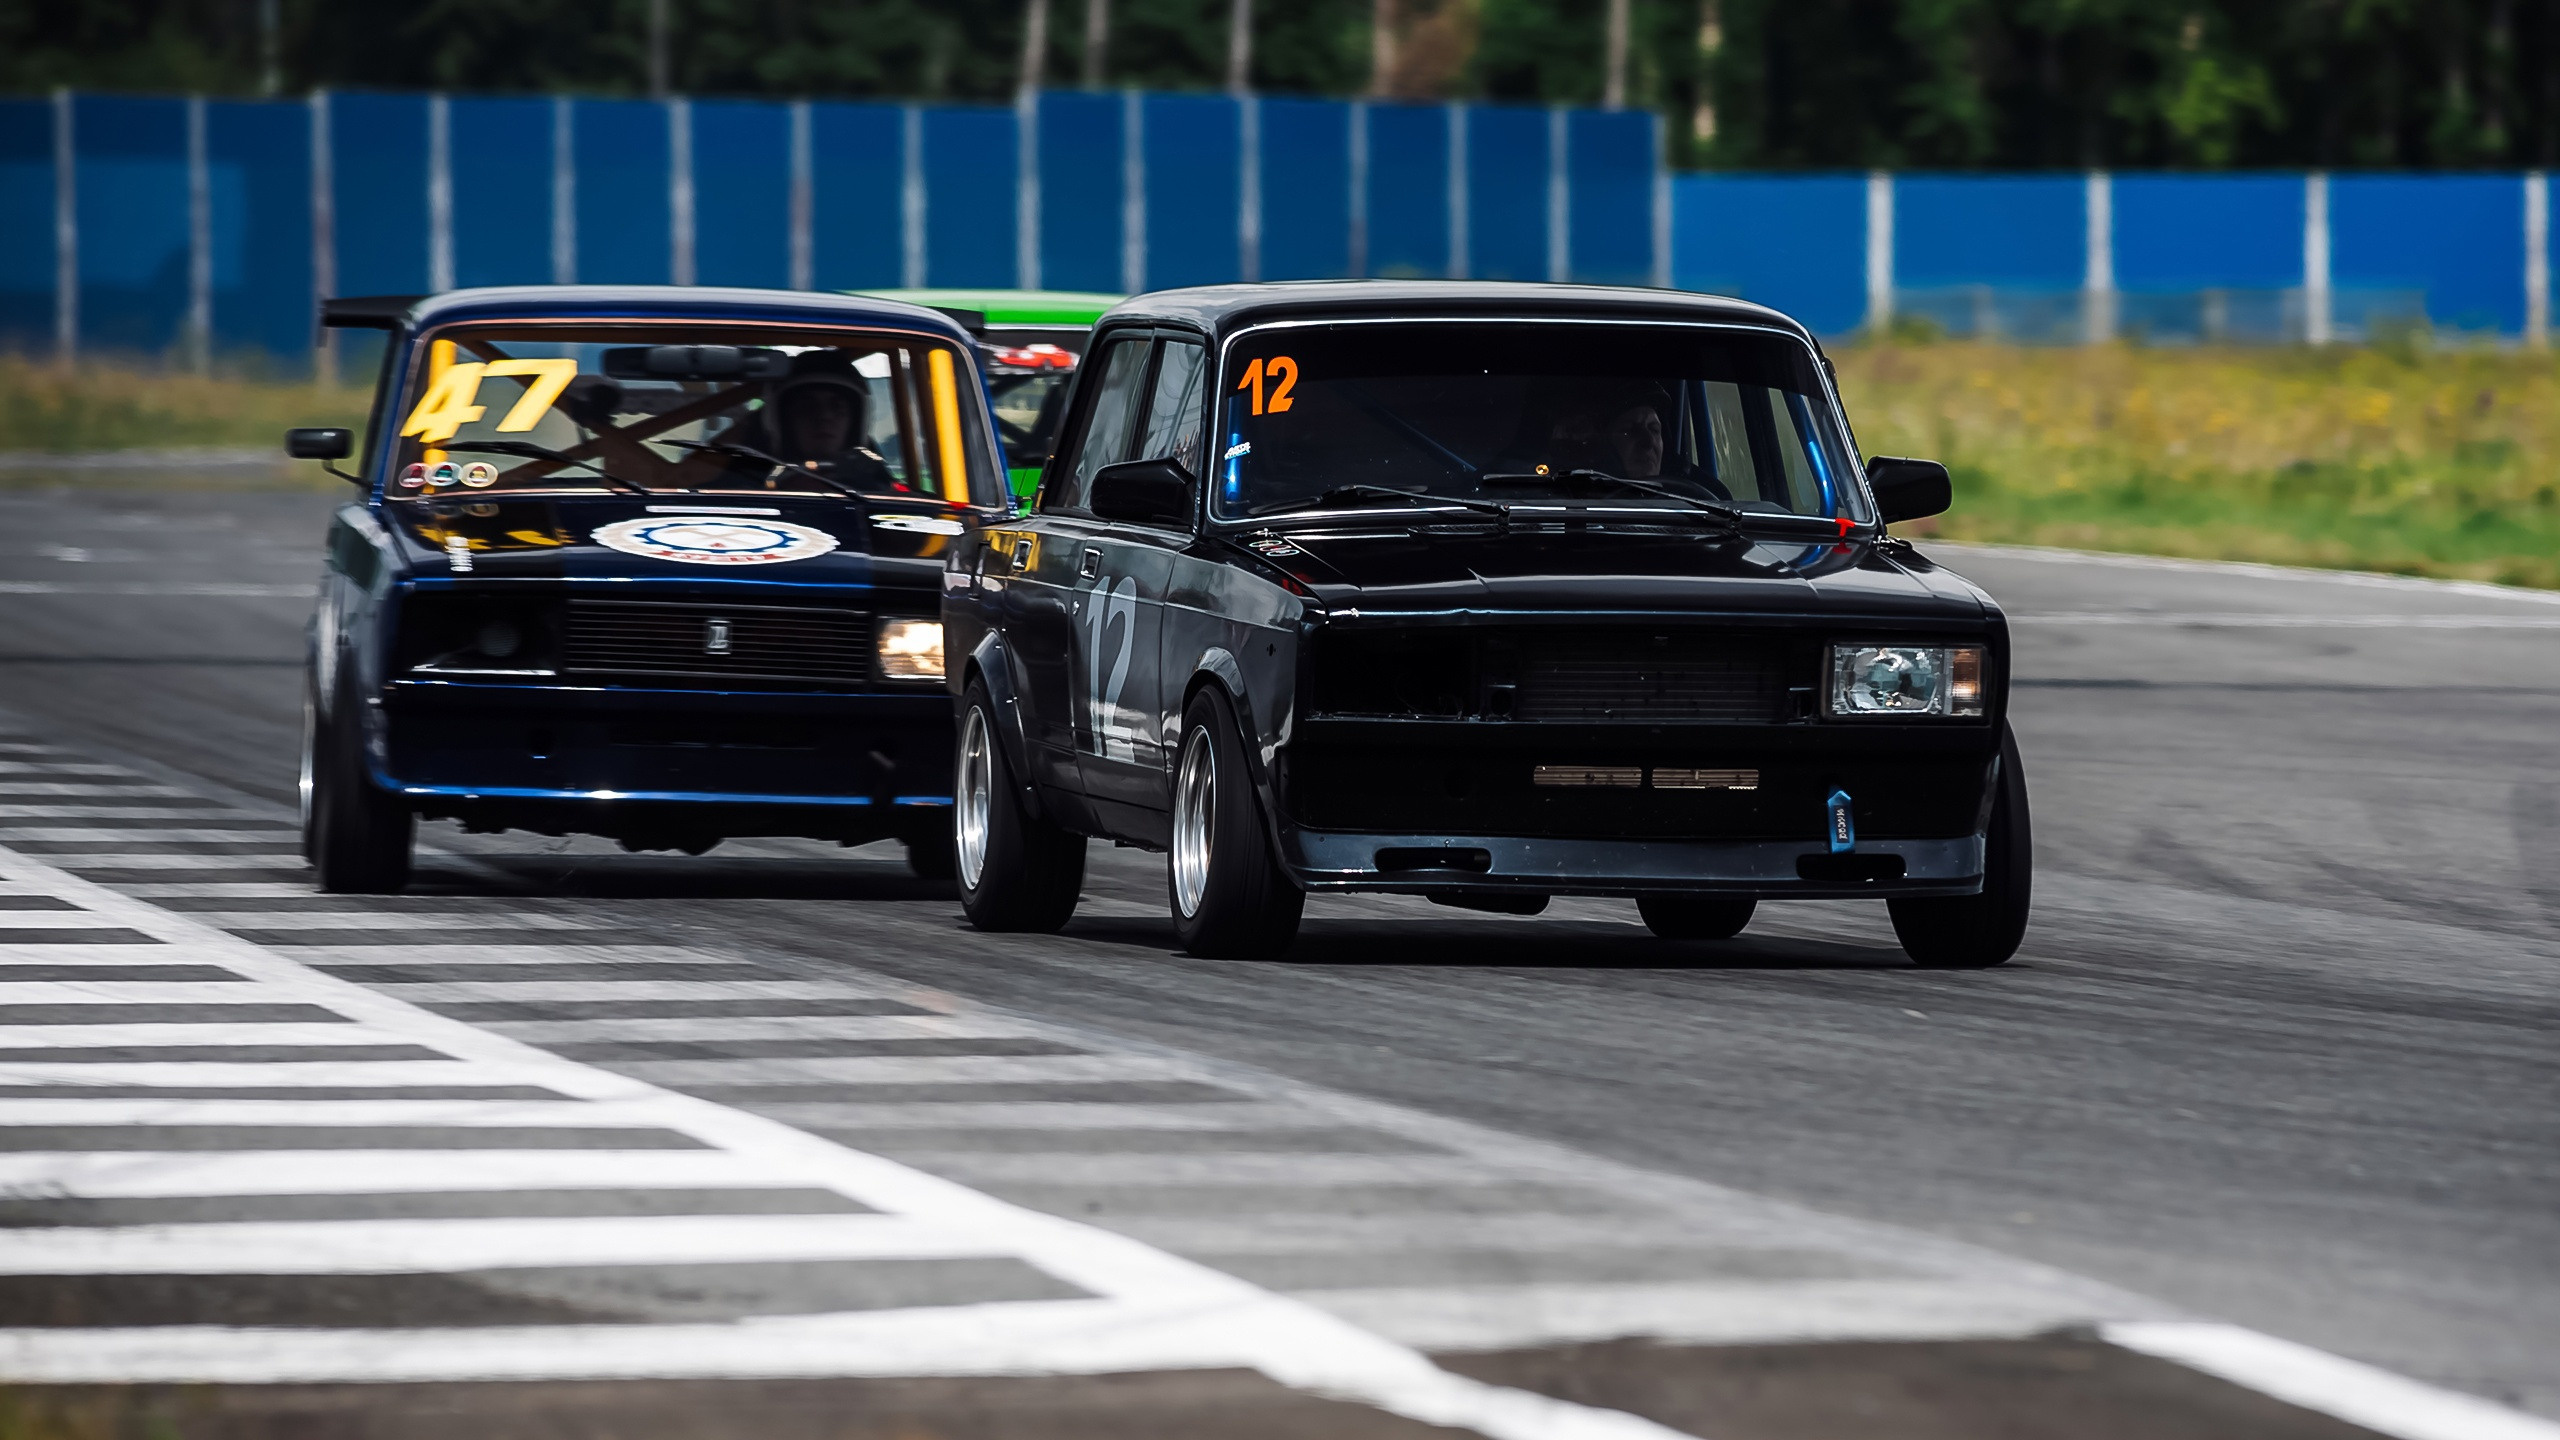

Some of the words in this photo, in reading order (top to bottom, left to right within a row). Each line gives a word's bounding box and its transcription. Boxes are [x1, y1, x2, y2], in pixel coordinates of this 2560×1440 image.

[399, 358, 578, 443] 47
[1237, 356, 1299, 416] 12
[1085, 576, 1137, 764] 12
